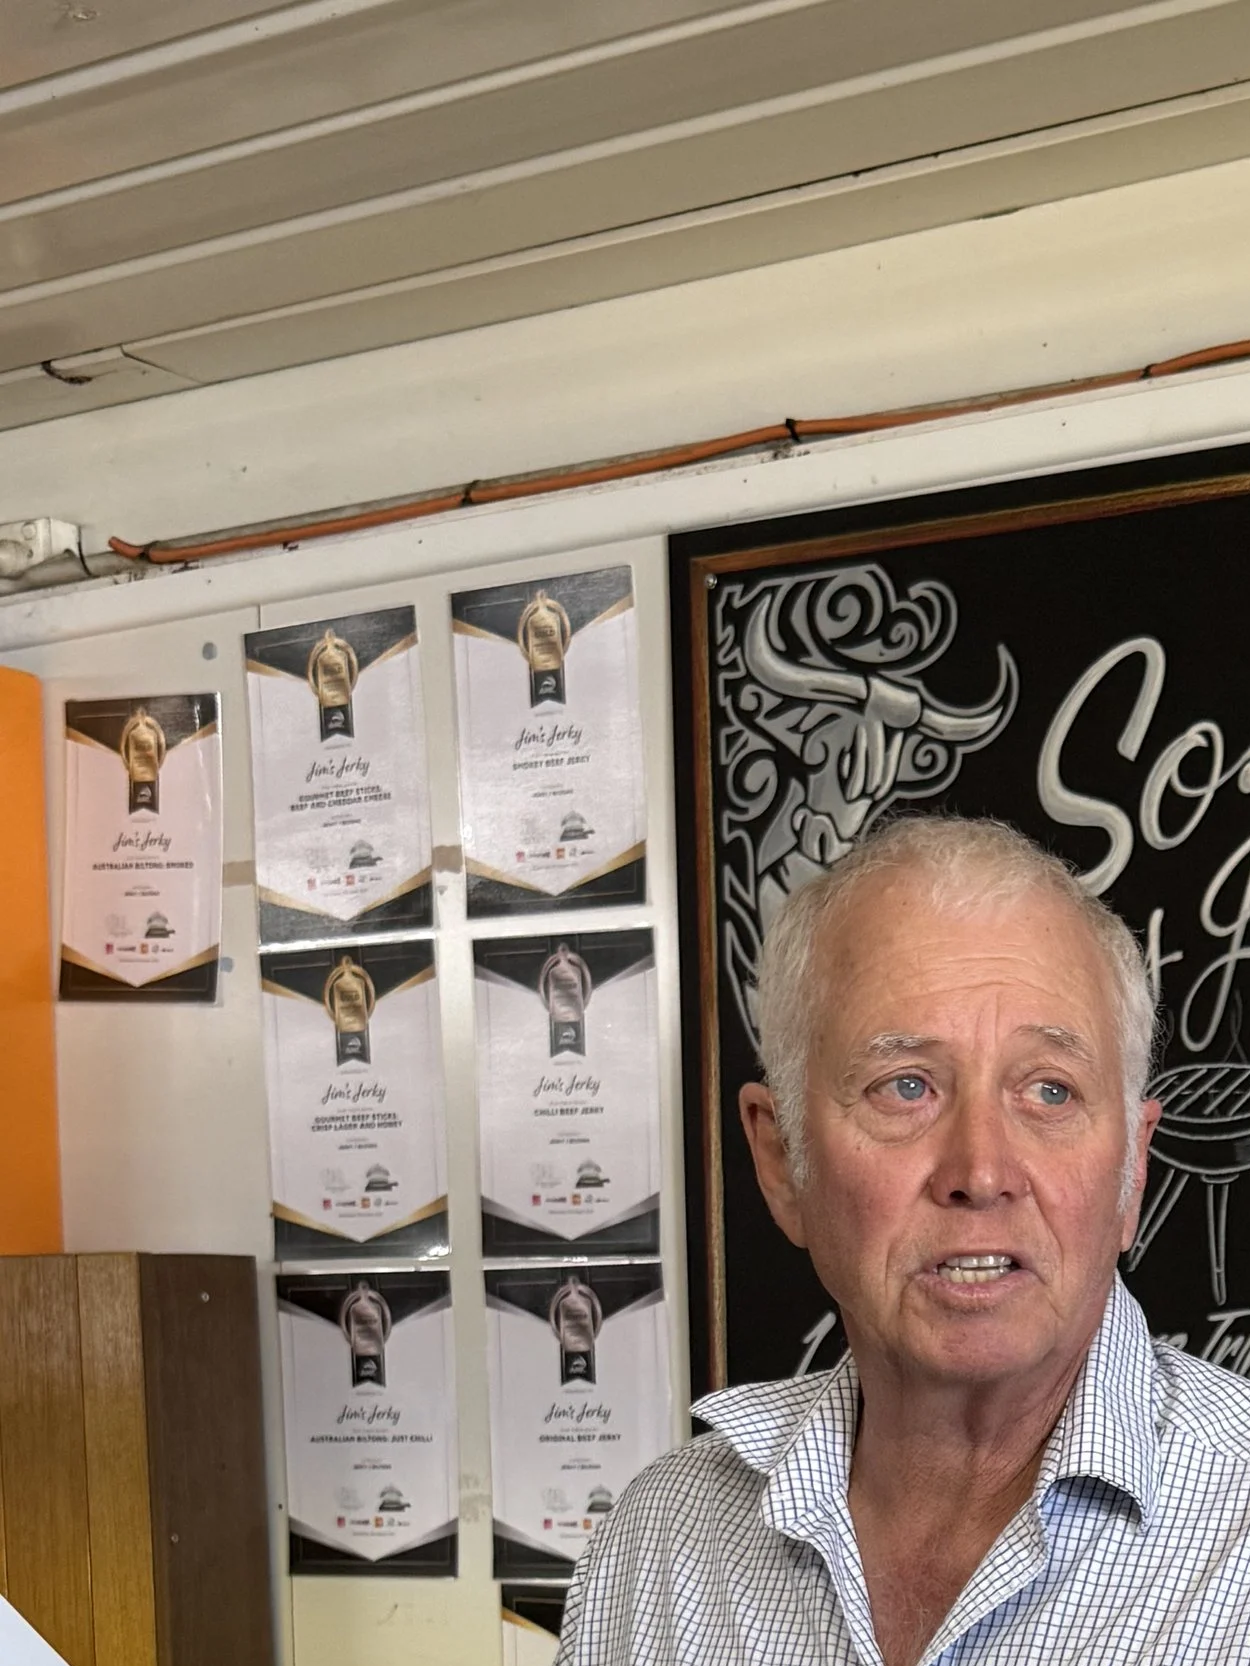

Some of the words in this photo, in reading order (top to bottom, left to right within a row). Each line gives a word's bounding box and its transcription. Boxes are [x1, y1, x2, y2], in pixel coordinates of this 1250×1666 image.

[514, 725, 546, 751] Jim's
[547, 724, 584, 748] Jerky
[306, 760, 335, 784] Jim's
[336, 756, 371, 779] Jerky
[113, 831, 141, 852] Jim's
[140, 831, 172, 852] Jerky
[322, 1083, 352, 1105] Jim's
[352, 1083, 387, 1103] Jerky
[533, 1075, 564, 1097] Jim's
[565, 1074, 602, 1097] Jerky
[559, 1108, 579, 1116] BEEF
[580, 1106, 605, 1115] JERKY
[337, 1404, 366, 1425] Jim's
[367, 1404, 402, 1426] Jerky
[544, 1402, 576, 1424] Jim's
[576, 1402, 613, 1424] Jerky
[577, 1434, 597, 1443] BEEF
[598, 1434, 622, 1442] JERKY
